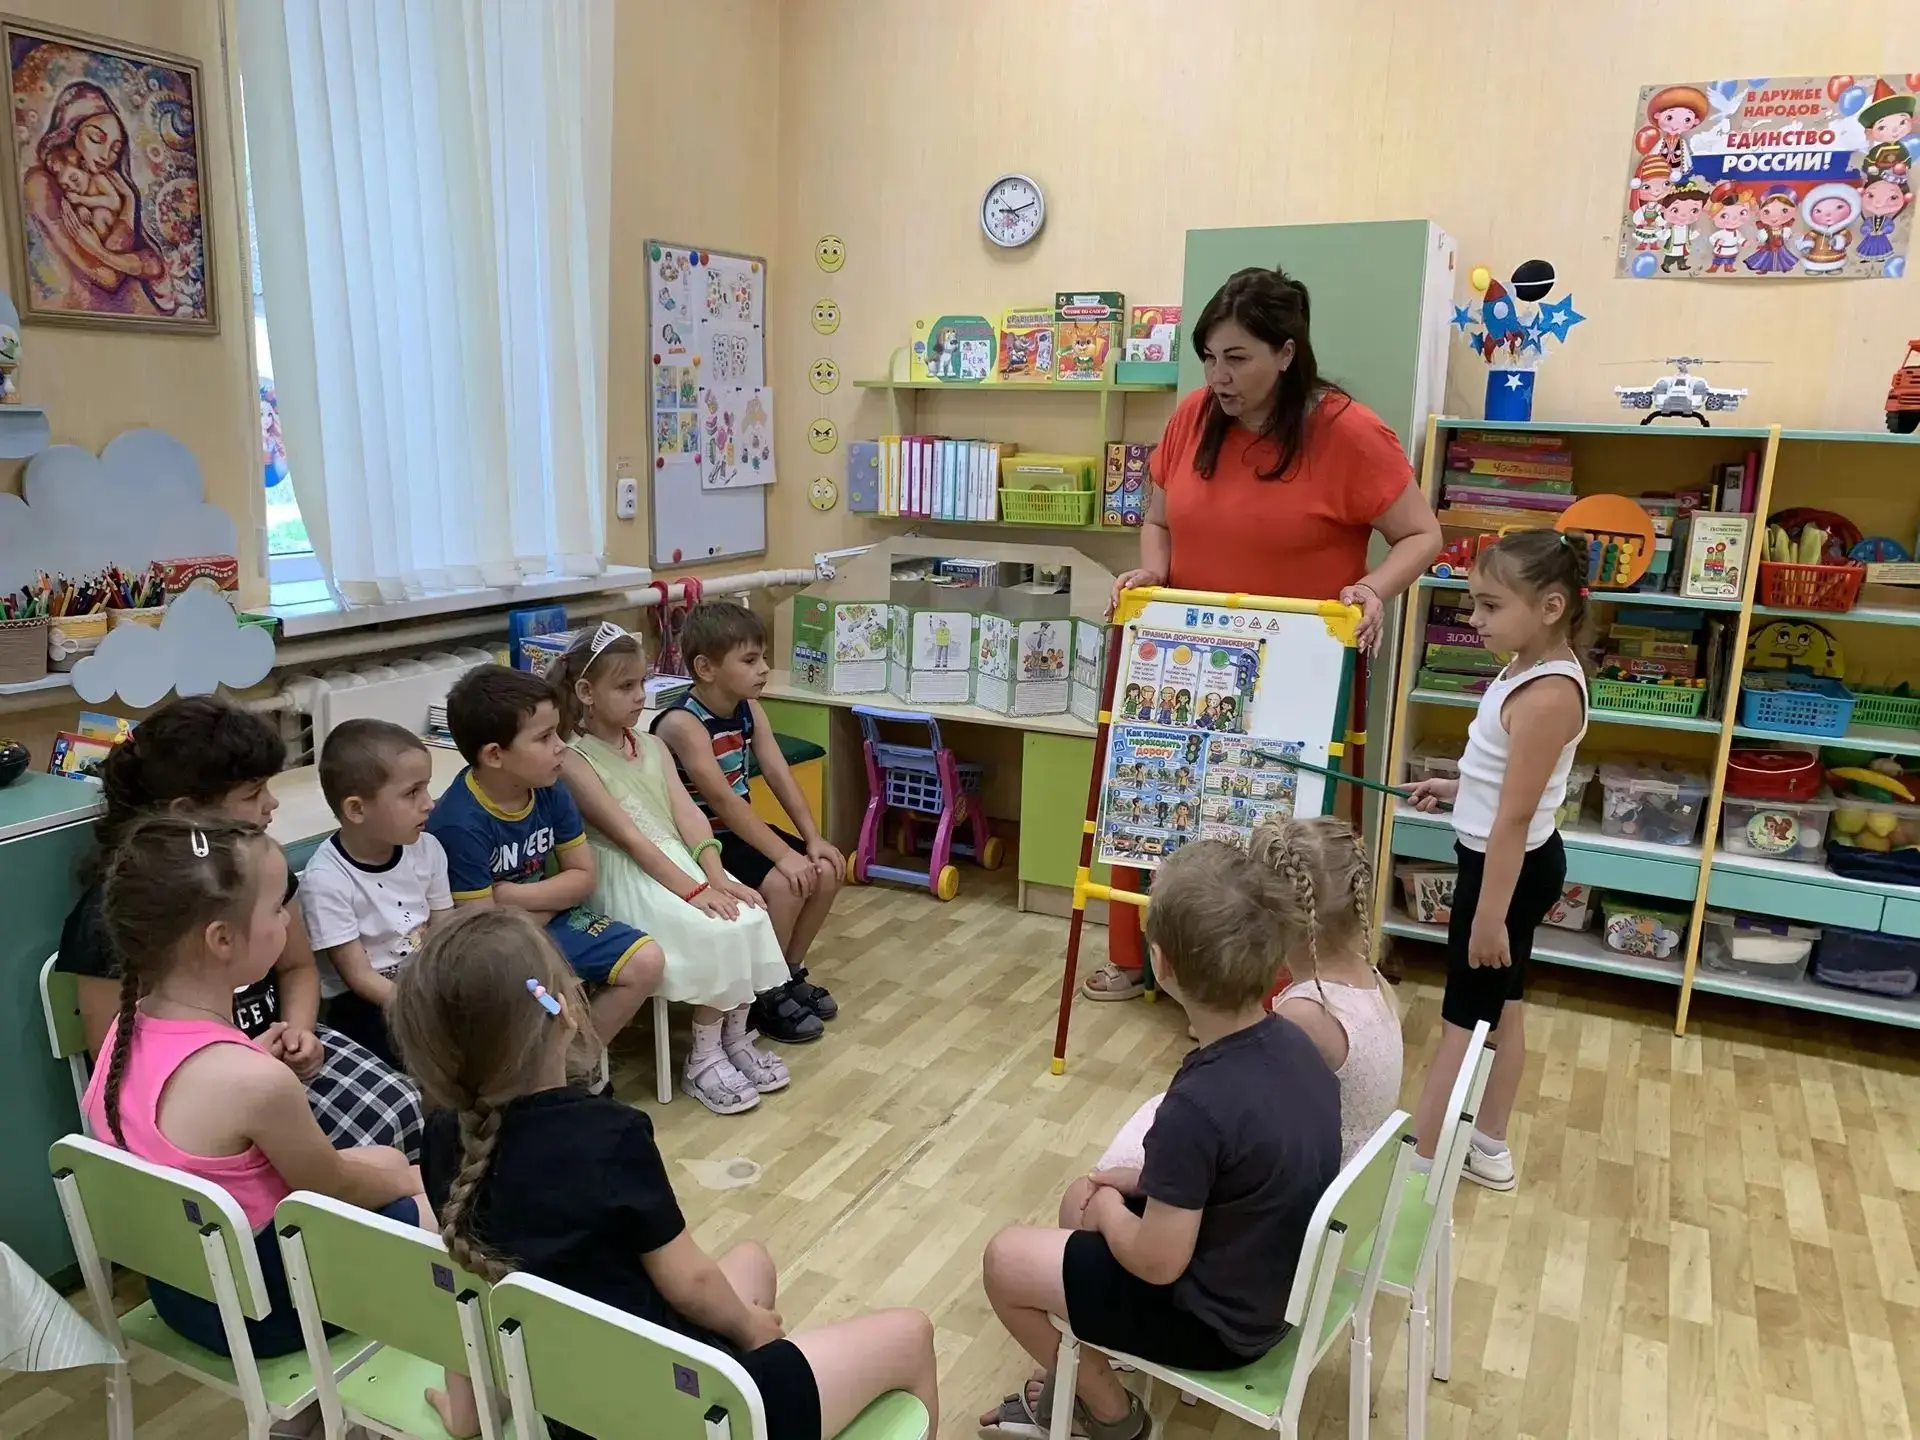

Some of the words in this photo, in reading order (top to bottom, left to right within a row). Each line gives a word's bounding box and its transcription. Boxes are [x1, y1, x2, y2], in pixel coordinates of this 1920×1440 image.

[1747, 91, 1756, 101] В
[1760, 88, 1822, 102] ДРУЖБЕ
[1726, 130, 1836, 148] ЕДИНСТВО
[1722, 152, 1831, 173] РОССИИ!
[1000, 188, 1006, 196] 11
[1142, 630, 1172, 640] ПРАВИЛА
[1173, 633, 1215, 644] ДОРОЖНОГО
[1216, 637, 1255, 648] ДВИЖЕНИЯ
[1126, 729, 1142, 738] Как
[1144, 730, 1187, 741] правильно
[1129, 738, 1182, 749] переходить
[1135, 747, 1173, 759] дорогу
